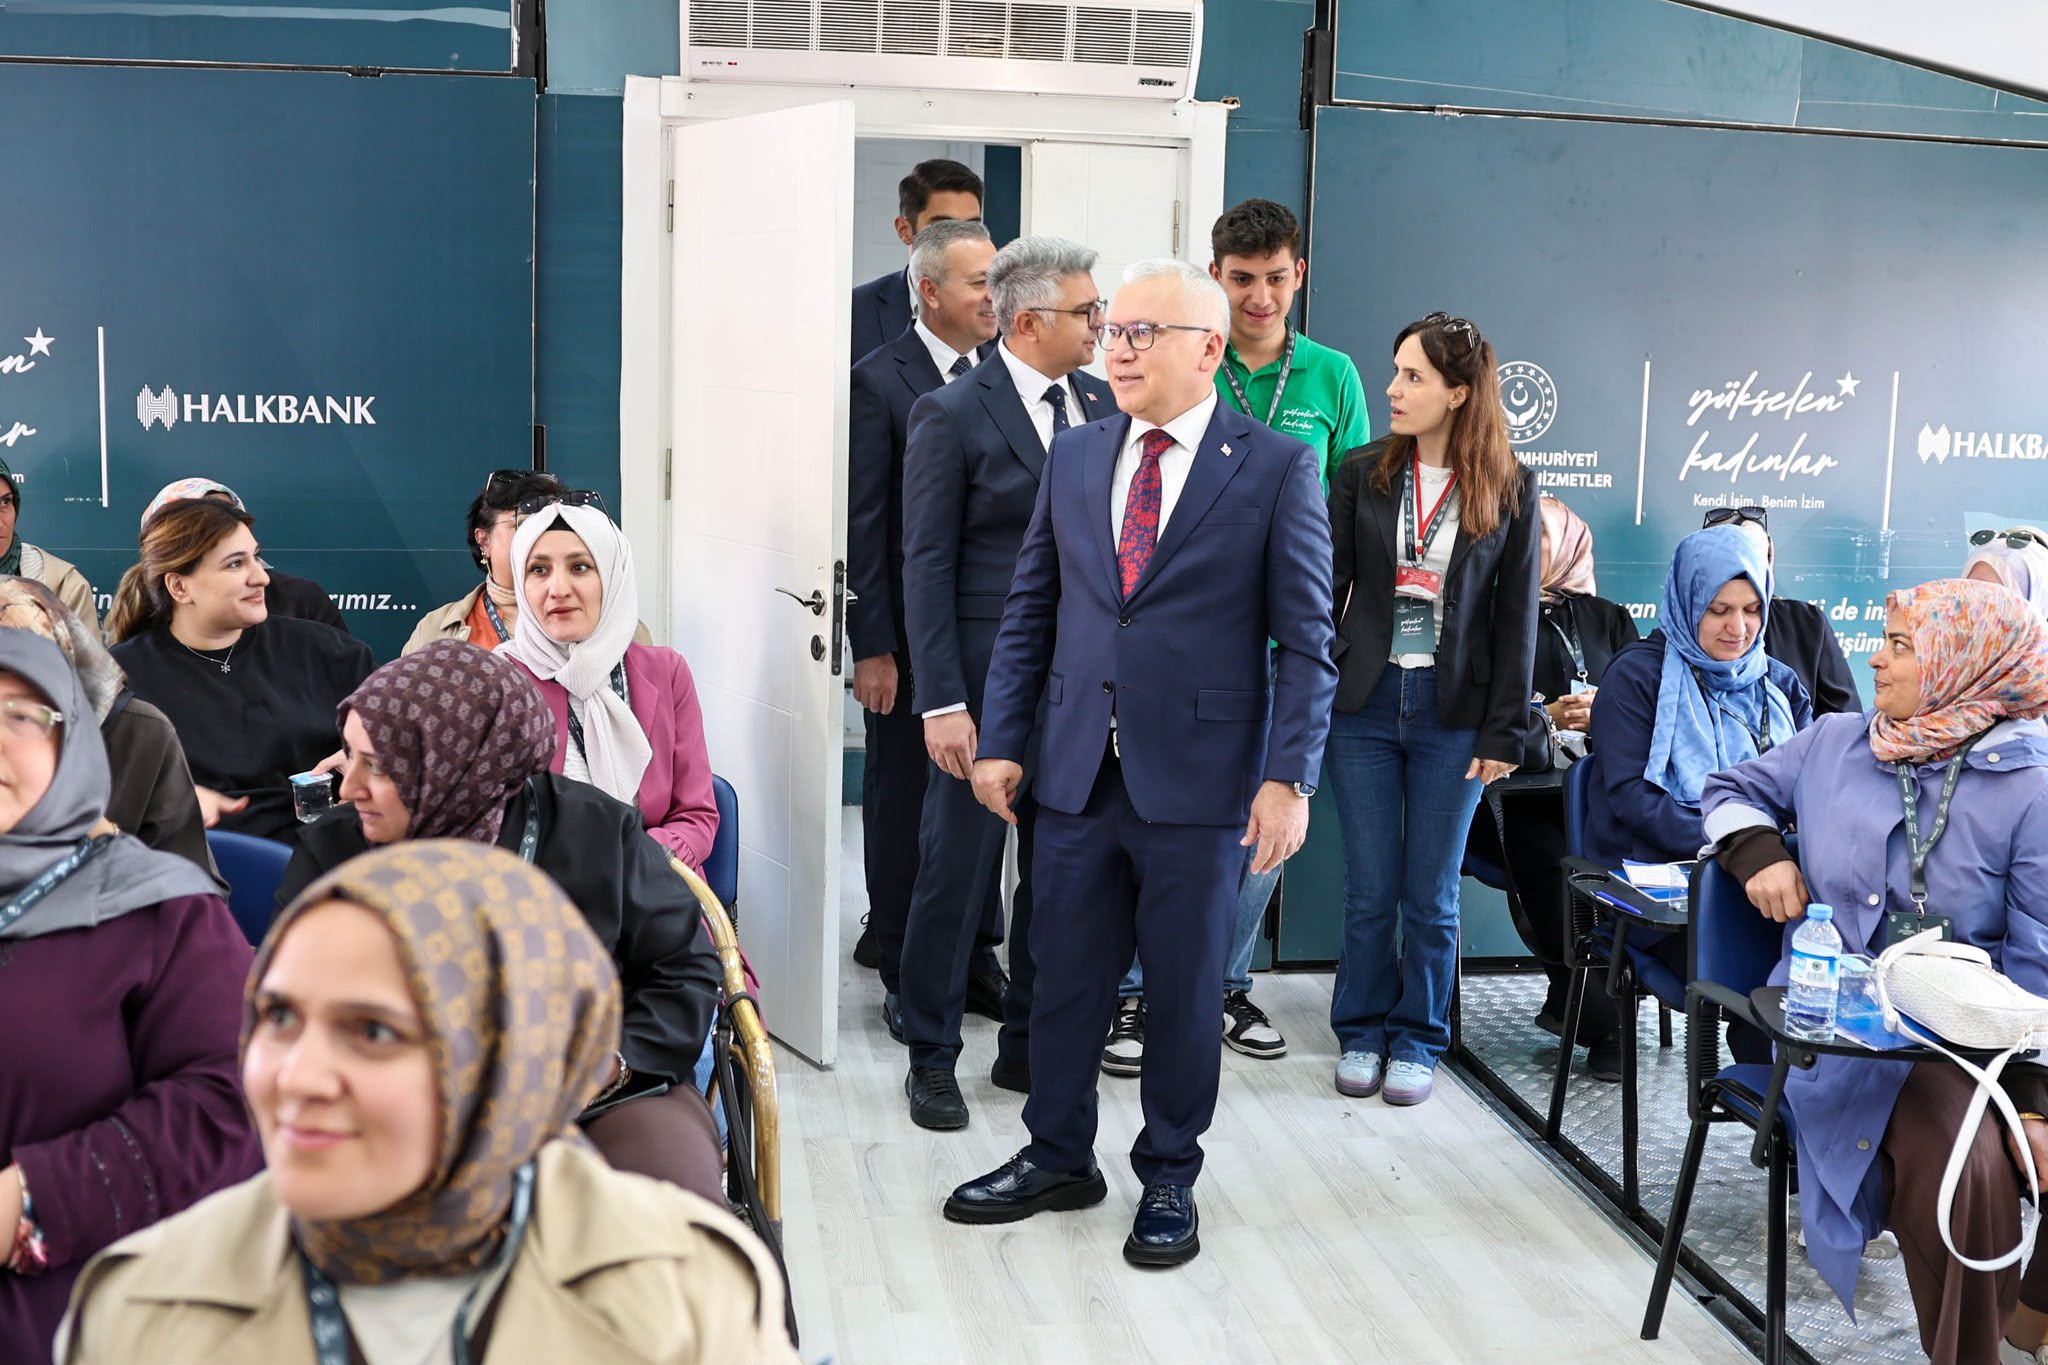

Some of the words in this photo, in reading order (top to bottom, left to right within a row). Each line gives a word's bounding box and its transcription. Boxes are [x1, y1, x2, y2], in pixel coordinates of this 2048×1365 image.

[183, 394, 377, 425] HALKBANK
[1687, 370, 1844, 426] yükselen
[1679, 430, 1839, 483] kadınlar
[1693, 493, 1727, 507] Kendi
[1762, 495, 1798, 508] Benim
[1801, 493, 1825, 509] İzim
[1830, 597, 1859, 621] de
